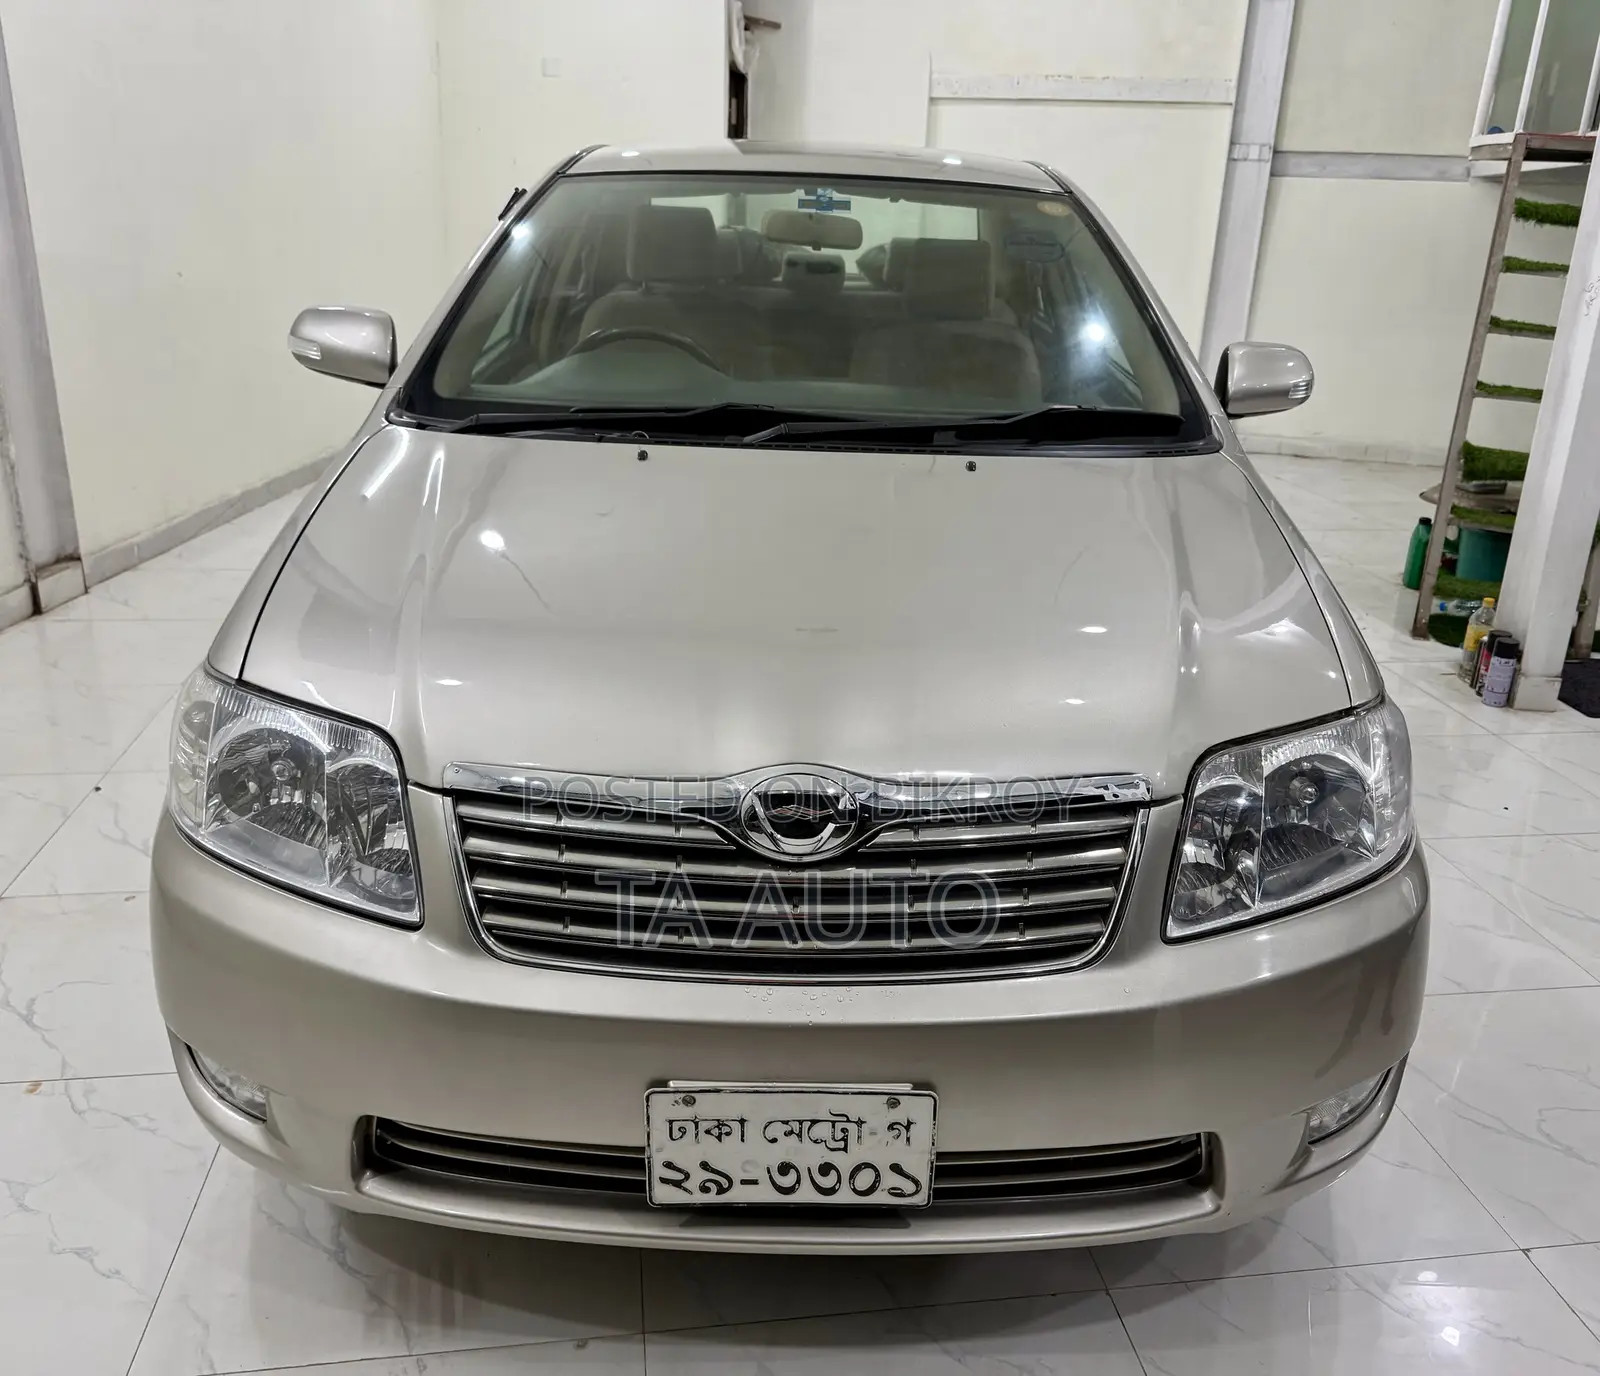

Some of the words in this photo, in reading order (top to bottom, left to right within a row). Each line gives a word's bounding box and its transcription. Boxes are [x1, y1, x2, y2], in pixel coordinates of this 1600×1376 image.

[665, 1115, 748, 1144] ঢাকা
[761, 1108, 867, 1153] মেট্রো
[887, 1118, 916, 1146] গ
[658, 1160, 923, 1198] ২৯-৩৩০১
